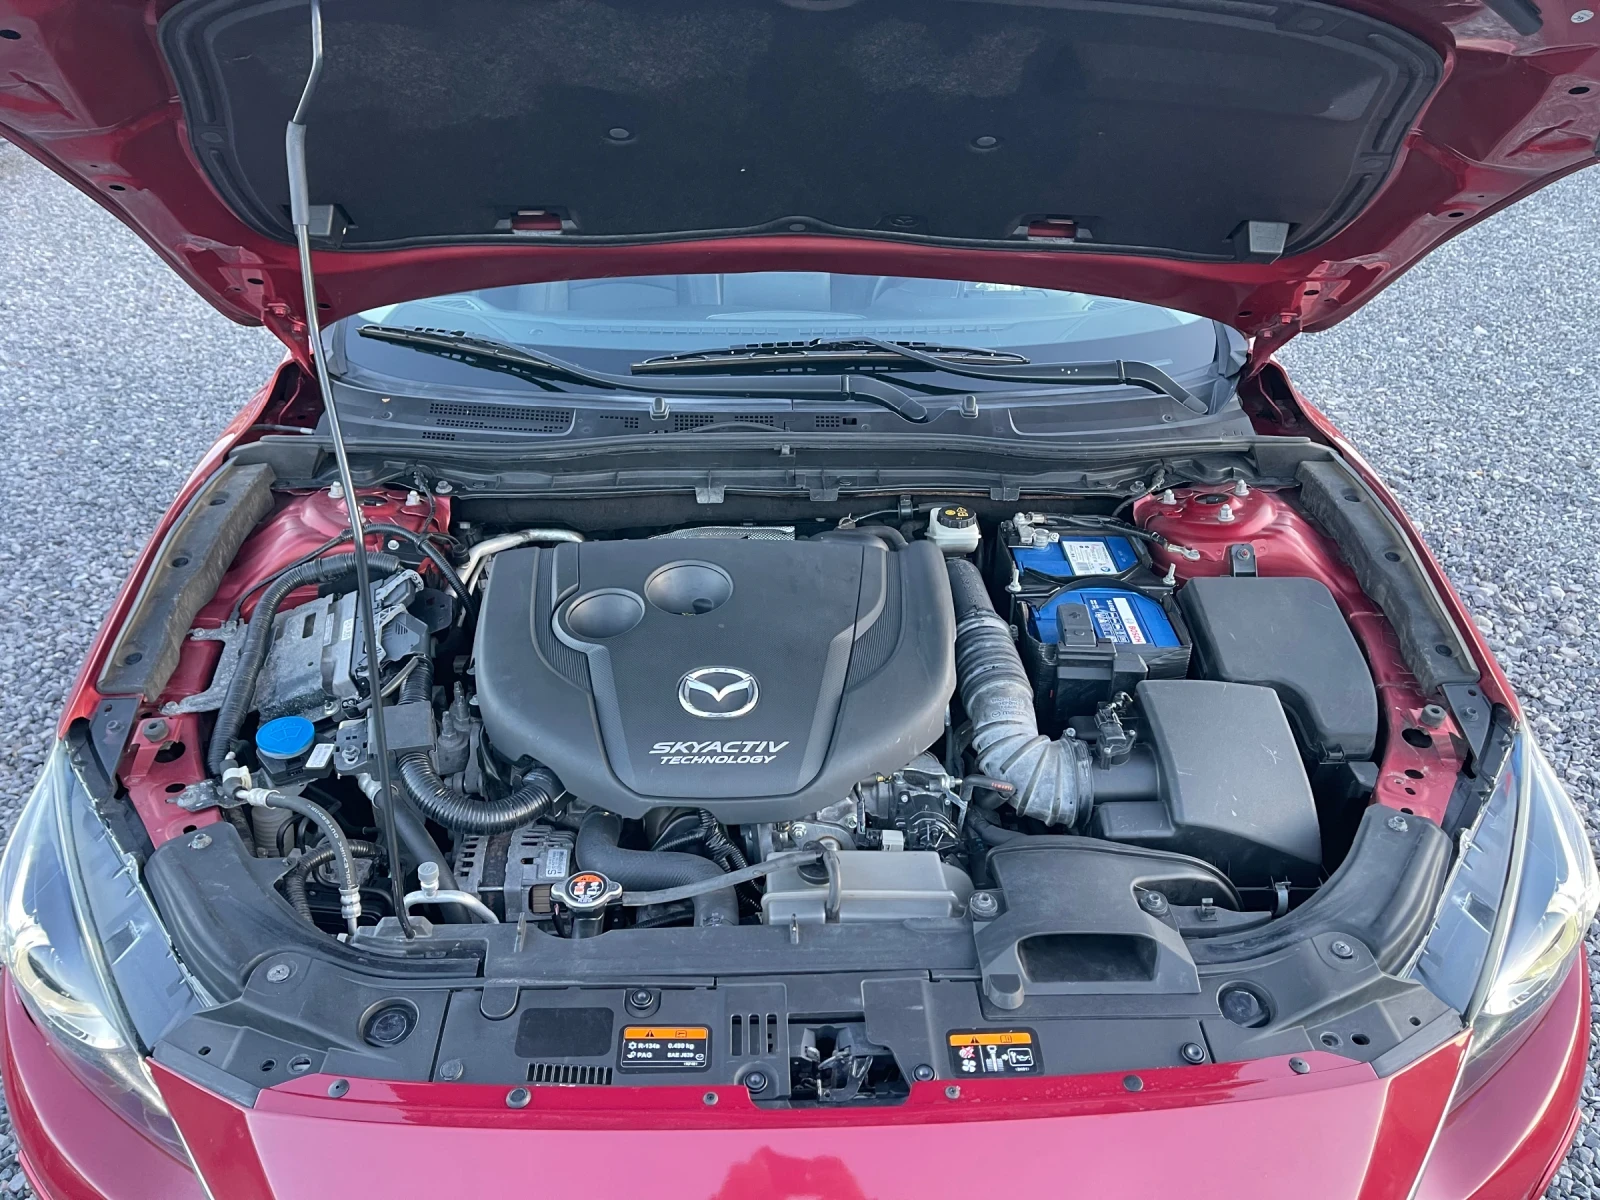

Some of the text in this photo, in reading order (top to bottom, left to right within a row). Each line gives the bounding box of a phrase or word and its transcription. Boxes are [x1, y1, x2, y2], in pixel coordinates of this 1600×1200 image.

[1128, 625, 1142, 643] BOSCH
[649, 741, 789, 754] SKYACTIV
[660, 755, 777, 765] TECHNOLOGY
